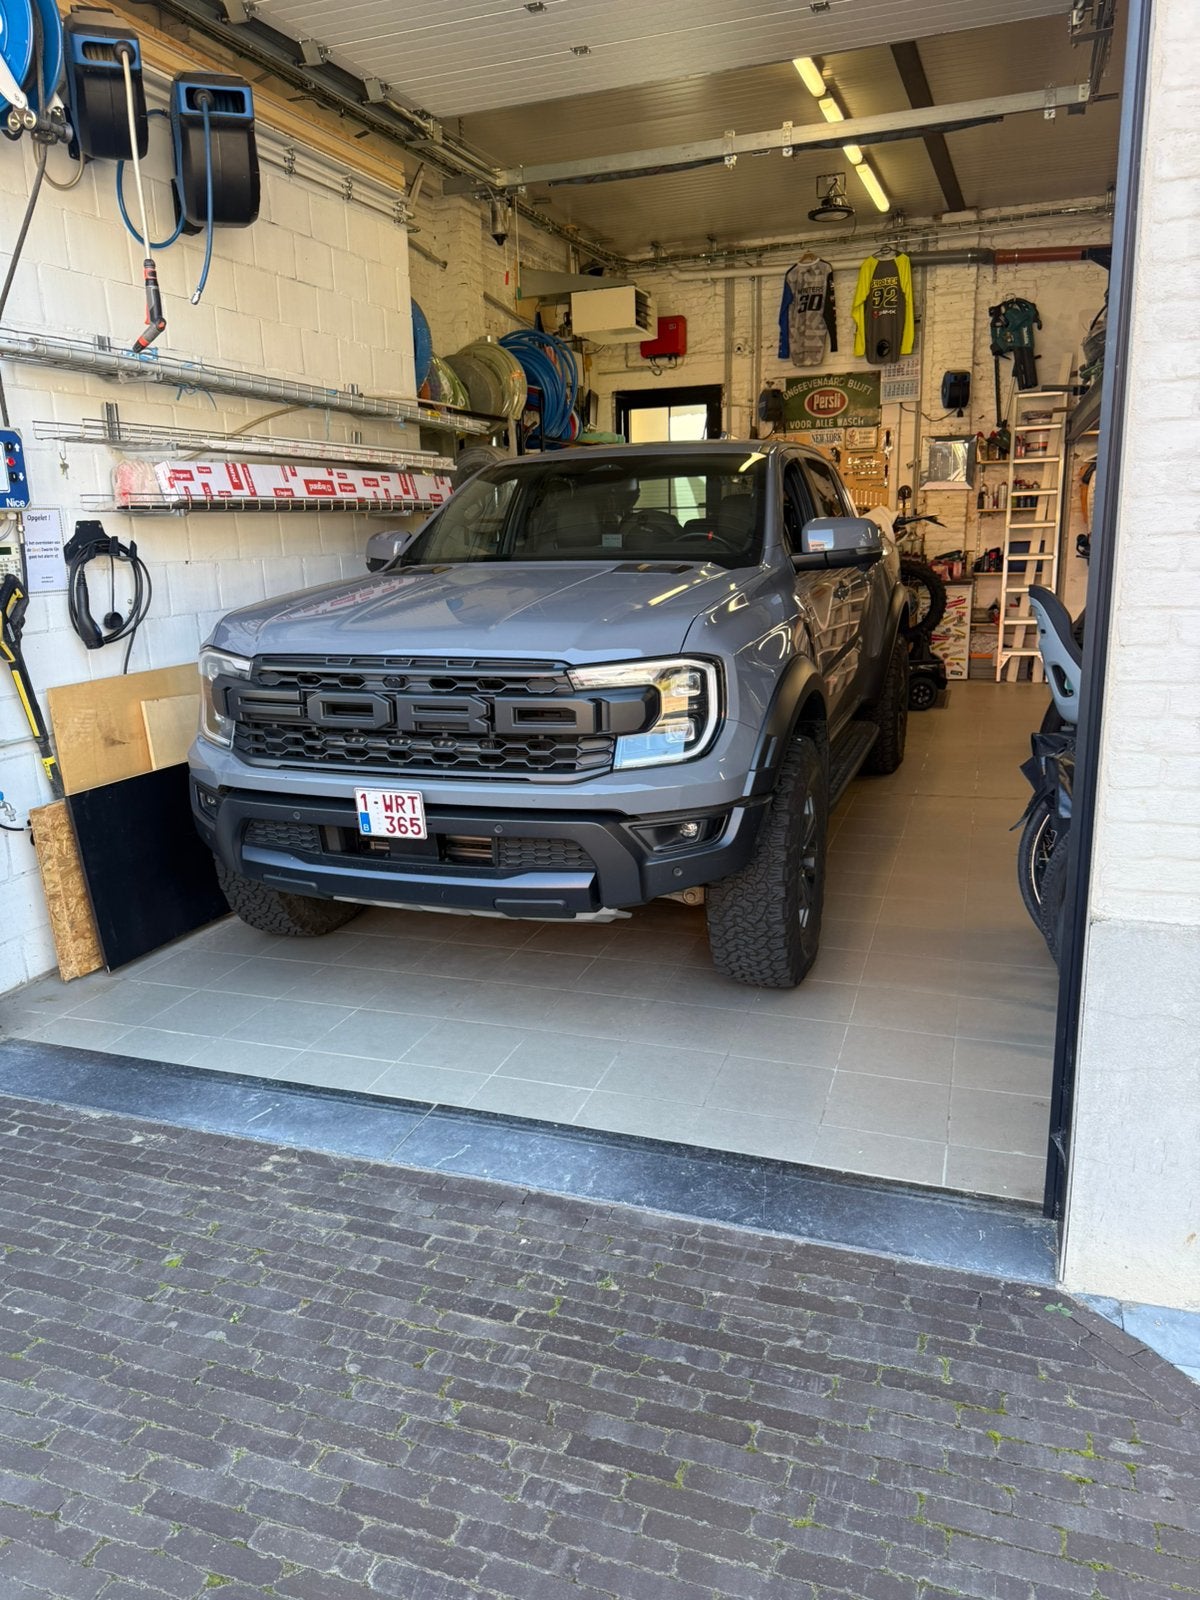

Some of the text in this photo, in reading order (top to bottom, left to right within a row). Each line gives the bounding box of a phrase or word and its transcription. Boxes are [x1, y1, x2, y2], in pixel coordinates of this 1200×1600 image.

[872, 286, 898, 308] 92
[790, 419, 812, 429] VOOR
[815, 418, 834, 428] ALLE
[6, 498, 26, 508] Nice
[27, 514, 47, 523] Opgelet
[228, 687, 595, 734] FORD
[360, 793, 418, 814] 1-WRT
[363, 824, 370, 832] B
[384, 815, 422, 836] 365
